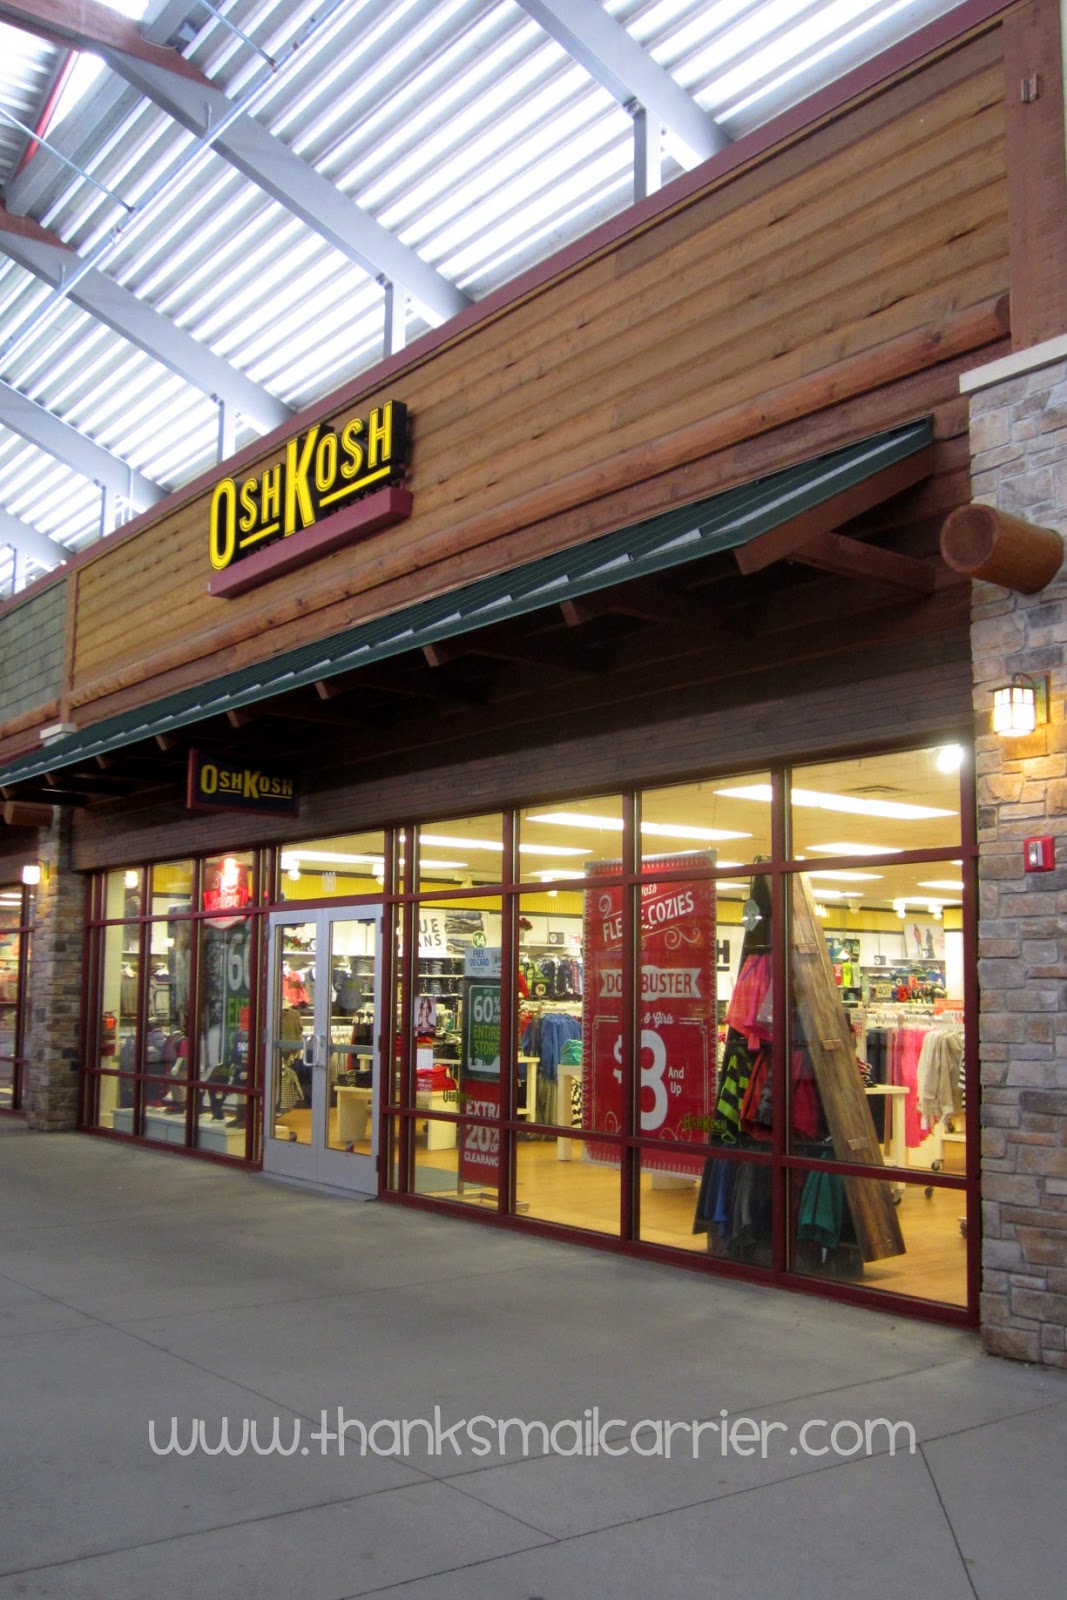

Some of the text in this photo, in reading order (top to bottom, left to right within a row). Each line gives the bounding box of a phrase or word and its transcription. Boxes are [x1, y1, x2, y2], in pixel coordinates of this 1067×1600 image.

[648, 891, 694, 925] COZIES
[652, 1011, 674, 1028] Girls
[668, 1066, 684, 1079] And
[670, 1082, 682, 1097] Up
[463, 1151, 499, 1168] CLEARANC
